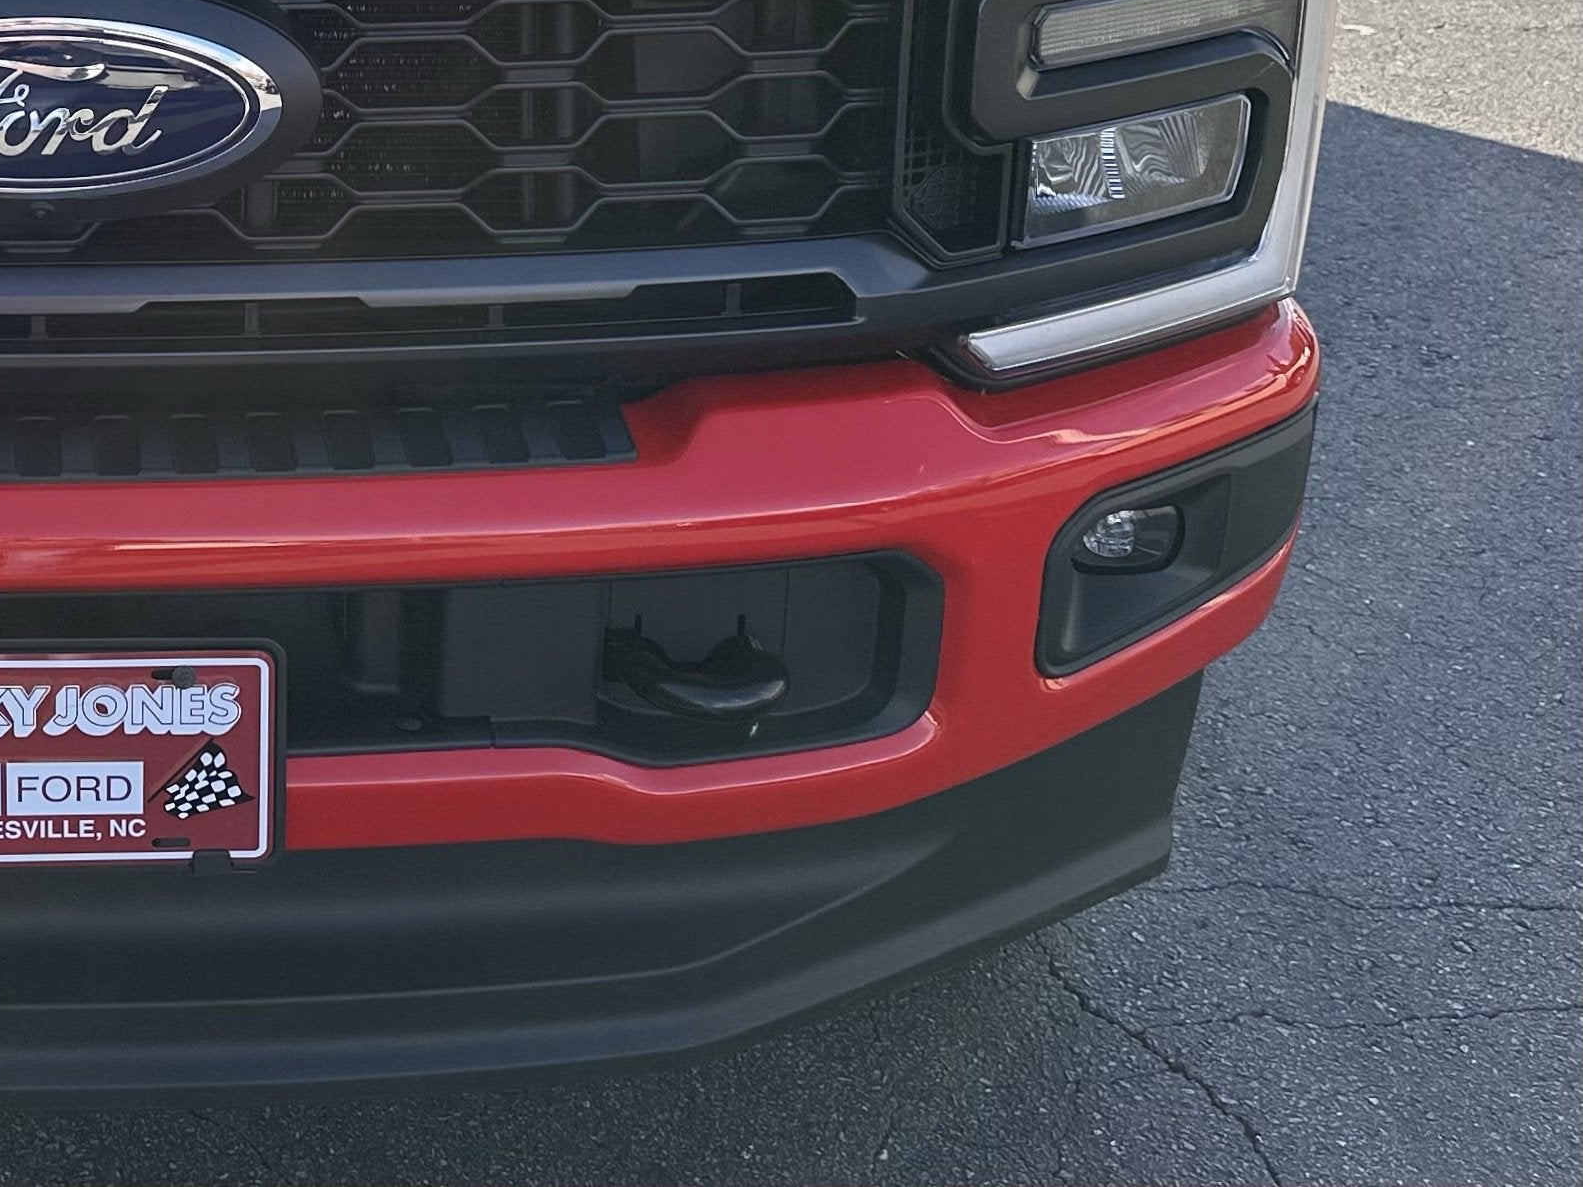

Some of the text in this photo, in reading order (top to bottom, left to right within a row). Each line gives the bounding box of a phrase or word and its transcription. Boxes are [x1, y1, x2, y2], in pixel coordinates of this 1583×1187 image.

[43, 683, 242, 736] JONES
[17, 775, 133, 803] FORD
[109, 818, 146, 838] NC
